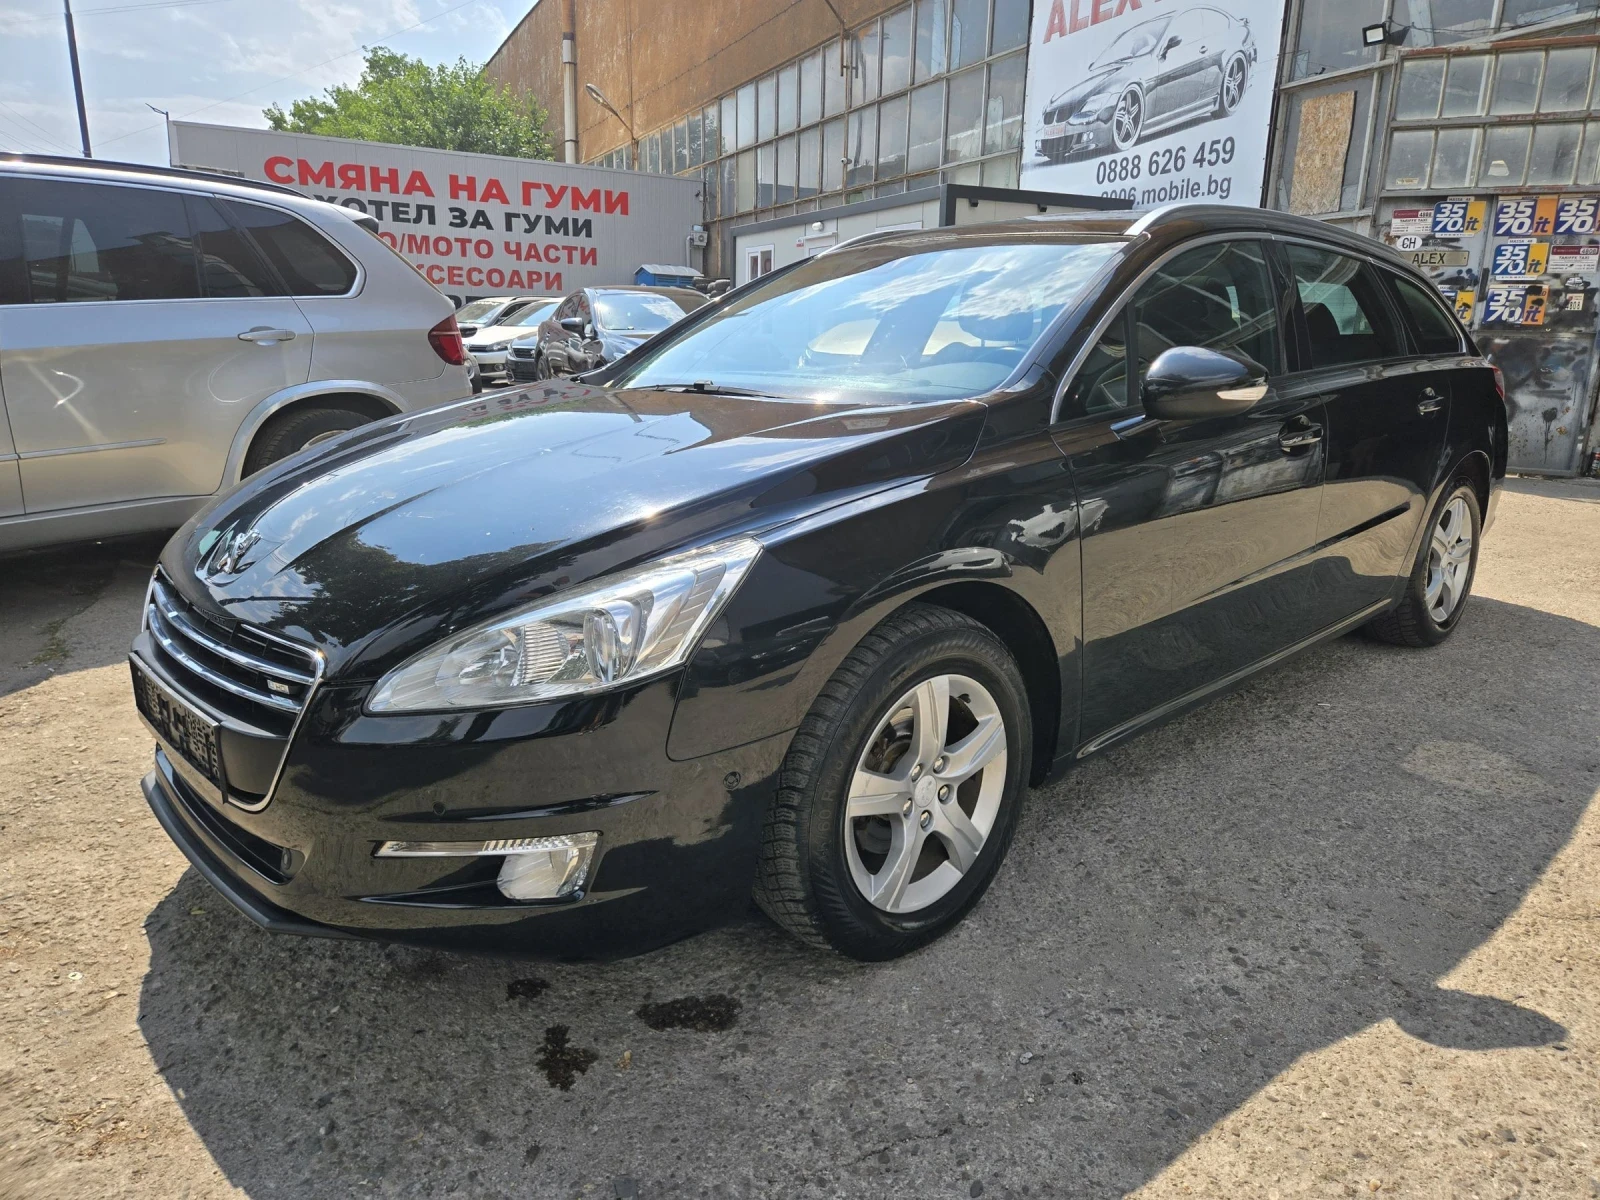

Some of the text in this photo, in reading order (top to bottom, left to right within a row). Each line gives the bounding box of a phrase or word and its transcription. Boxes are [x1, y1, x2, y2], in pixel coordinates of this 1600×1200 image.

[1096, 136, 1235, 184] 0888 626 459
[264, 156, 630, 216] СМЯНА НА ГУМИ
[1436, 203, 1467, 218] 35
[1498, 201, 1535, 218] 35
[1559, 199, 1598, 217] 35
[448, 207, 494, 231] ЗА
[504, 212, 593, 239] ГУМИ
[504, 242, 597, 266] ЧАСТИ
[1411, 252, 1447, 264] ALEX
[1496, 245, 1528, 260] 35
[1489, 291, 1526, 306] 35
